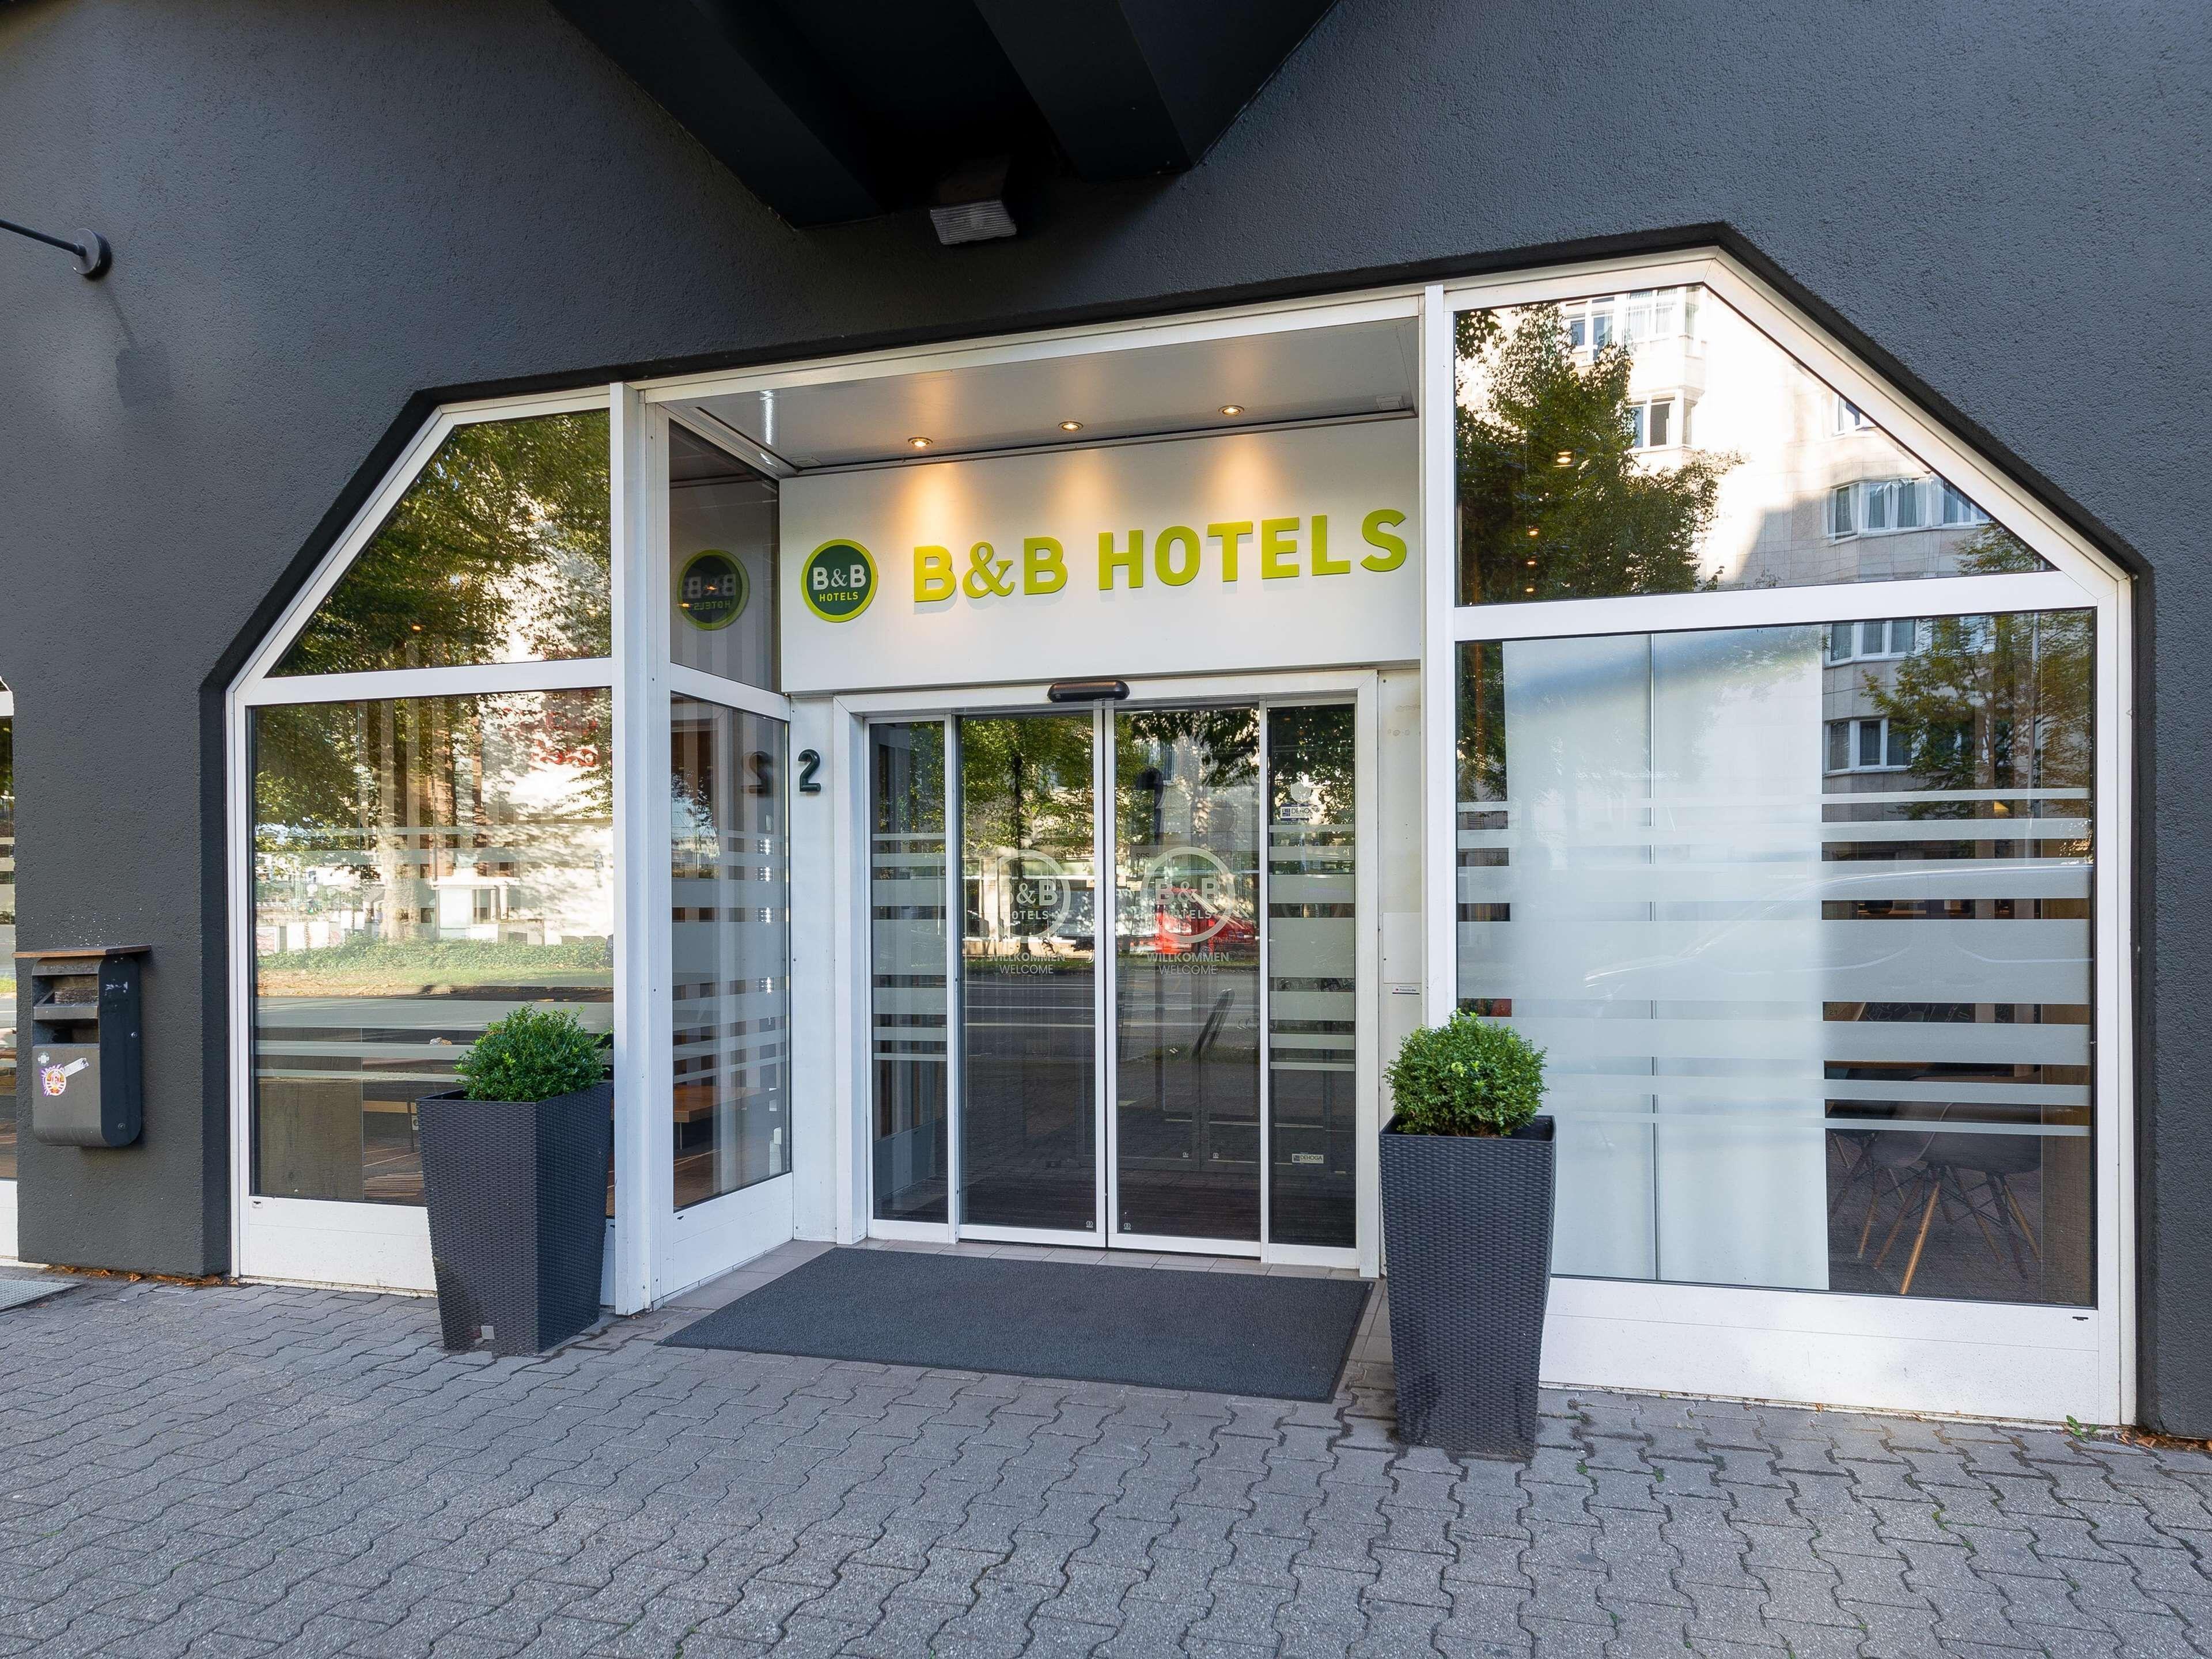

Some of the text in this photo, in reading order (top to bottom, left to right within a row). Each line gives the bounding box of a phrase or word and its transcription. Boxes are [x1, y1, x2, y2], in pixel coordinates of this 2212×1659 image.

[914, 509, 1407, 602] B&B HOTELS
[813, 564, 866, 590] B&B
[819, 592, 858, 602] HOTELS
[797, 749, 821, 792] 2
[1155, 878, 1219, 905] B&B
[1010, 910, 1049, 920] OTELS
[1147, 952, 1229, 962] WILLKOMMEN
[999, 964, 1054, 974] WELCOME
[1158, 965, 1217, 975] WELCOME
